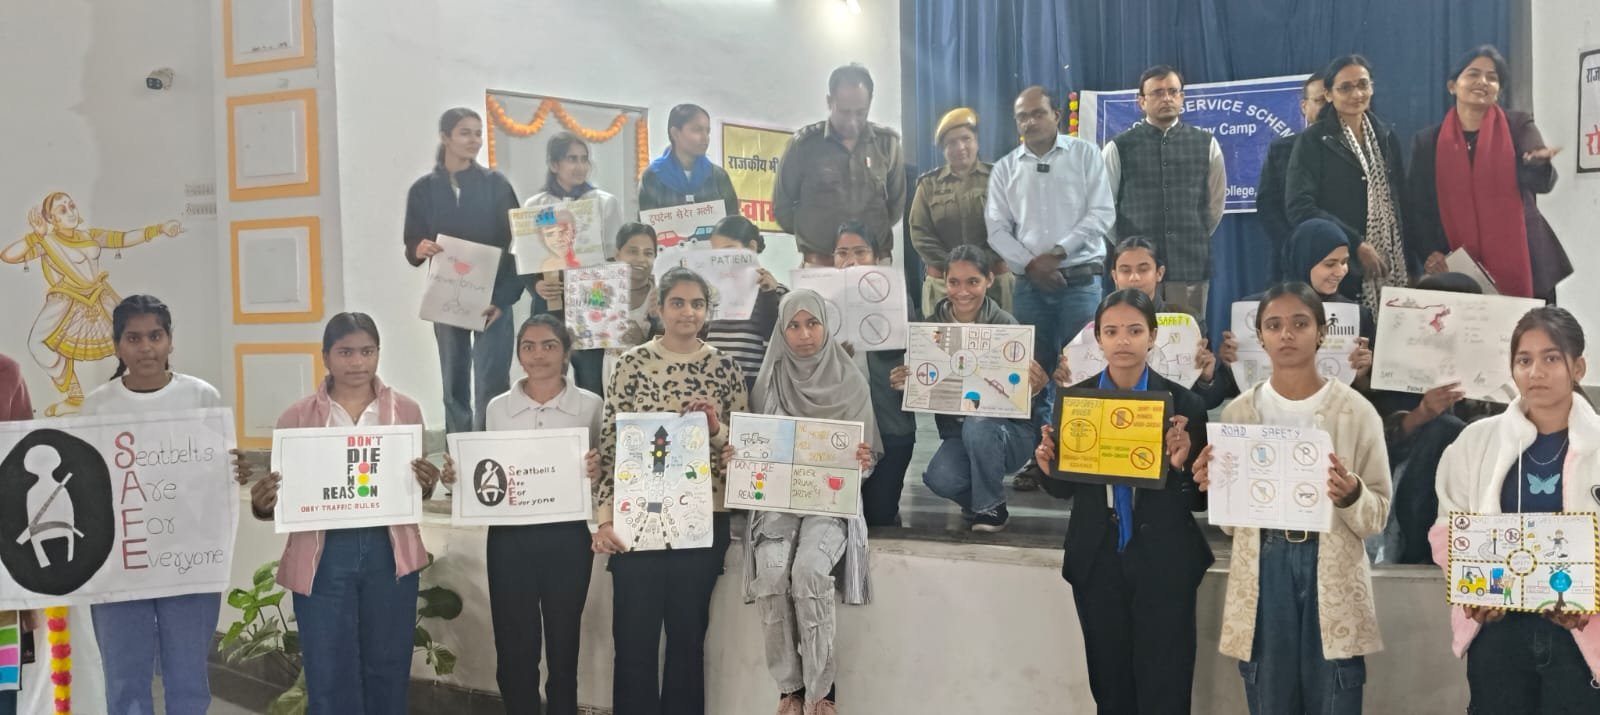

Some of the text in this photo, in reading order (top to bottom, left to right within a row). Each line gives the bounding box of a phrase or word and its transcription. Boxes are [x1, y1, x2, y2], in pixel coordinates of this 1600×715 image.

[1219, 122, 1257, 136] Camp
[1225, 185, 1258, 198] ollege,
[711, 255, 753, 264] PATIENT
[1221, 425, 1301, 440] ROAD SAFETY
[347, 436, 383, 447] DON'T
[114, 431, 214, 469] Seatbelts
[347, 448, 380, 463] DIE
[793, 468, 816, 477] NEVER
[121, 470, 177, 504] Are
[323, 485, 378, 500] REASON
[322, 503, 352, 511] TRAFFIC
[122, 507, 175, 538] For
[122, 538, 224, 575] Everyone
